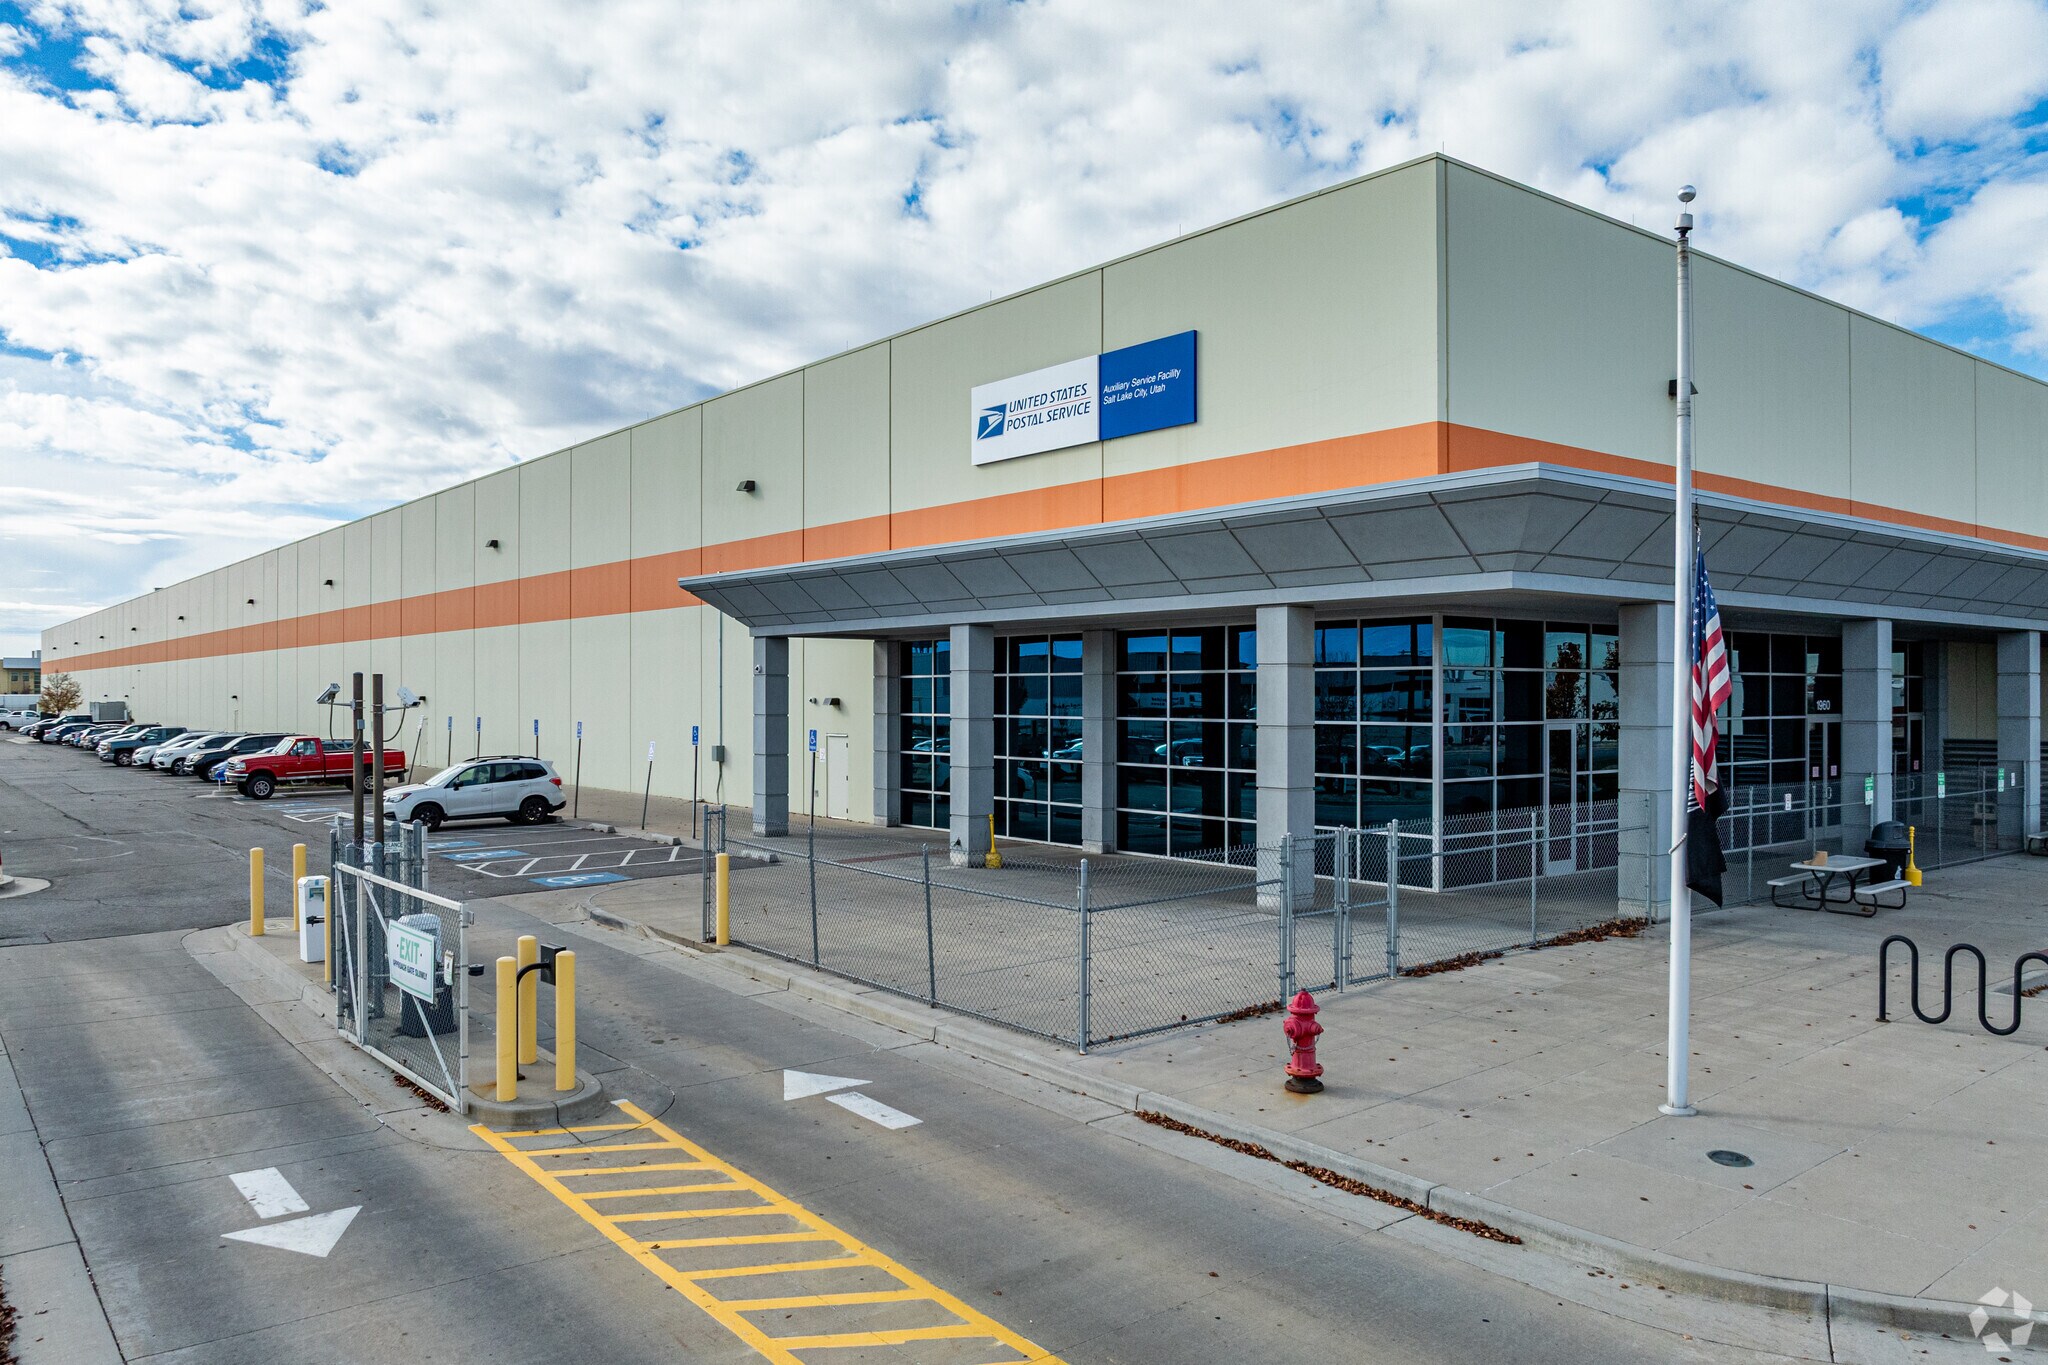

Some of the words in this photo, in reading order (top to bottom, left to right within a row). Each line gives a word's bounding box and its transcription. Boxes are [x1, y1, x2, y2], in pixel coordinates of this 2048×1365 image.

[1103, 381, 1130, 394] Auxiliary
[1131, 375, 1156, 387] Service
[1157, 368, 1182, 381] Facility
[1103, 394, 1116, 405] Salt
[1116, 391, 1133, 402] Lake
[1134, 388, 1148, 399] City,
[1149, 383, 1166, 395] Utah
[1009, 393, 1048, 413] UNITED
[1049, 383, 1088, 403] STATES
[1006, 412, 1044, 431] POSTAL
[1046, 401, 1091, 422] SERVICE
[1816, 700, 1831, 711] 1960
[399, 936, 420, 965] EXIT
